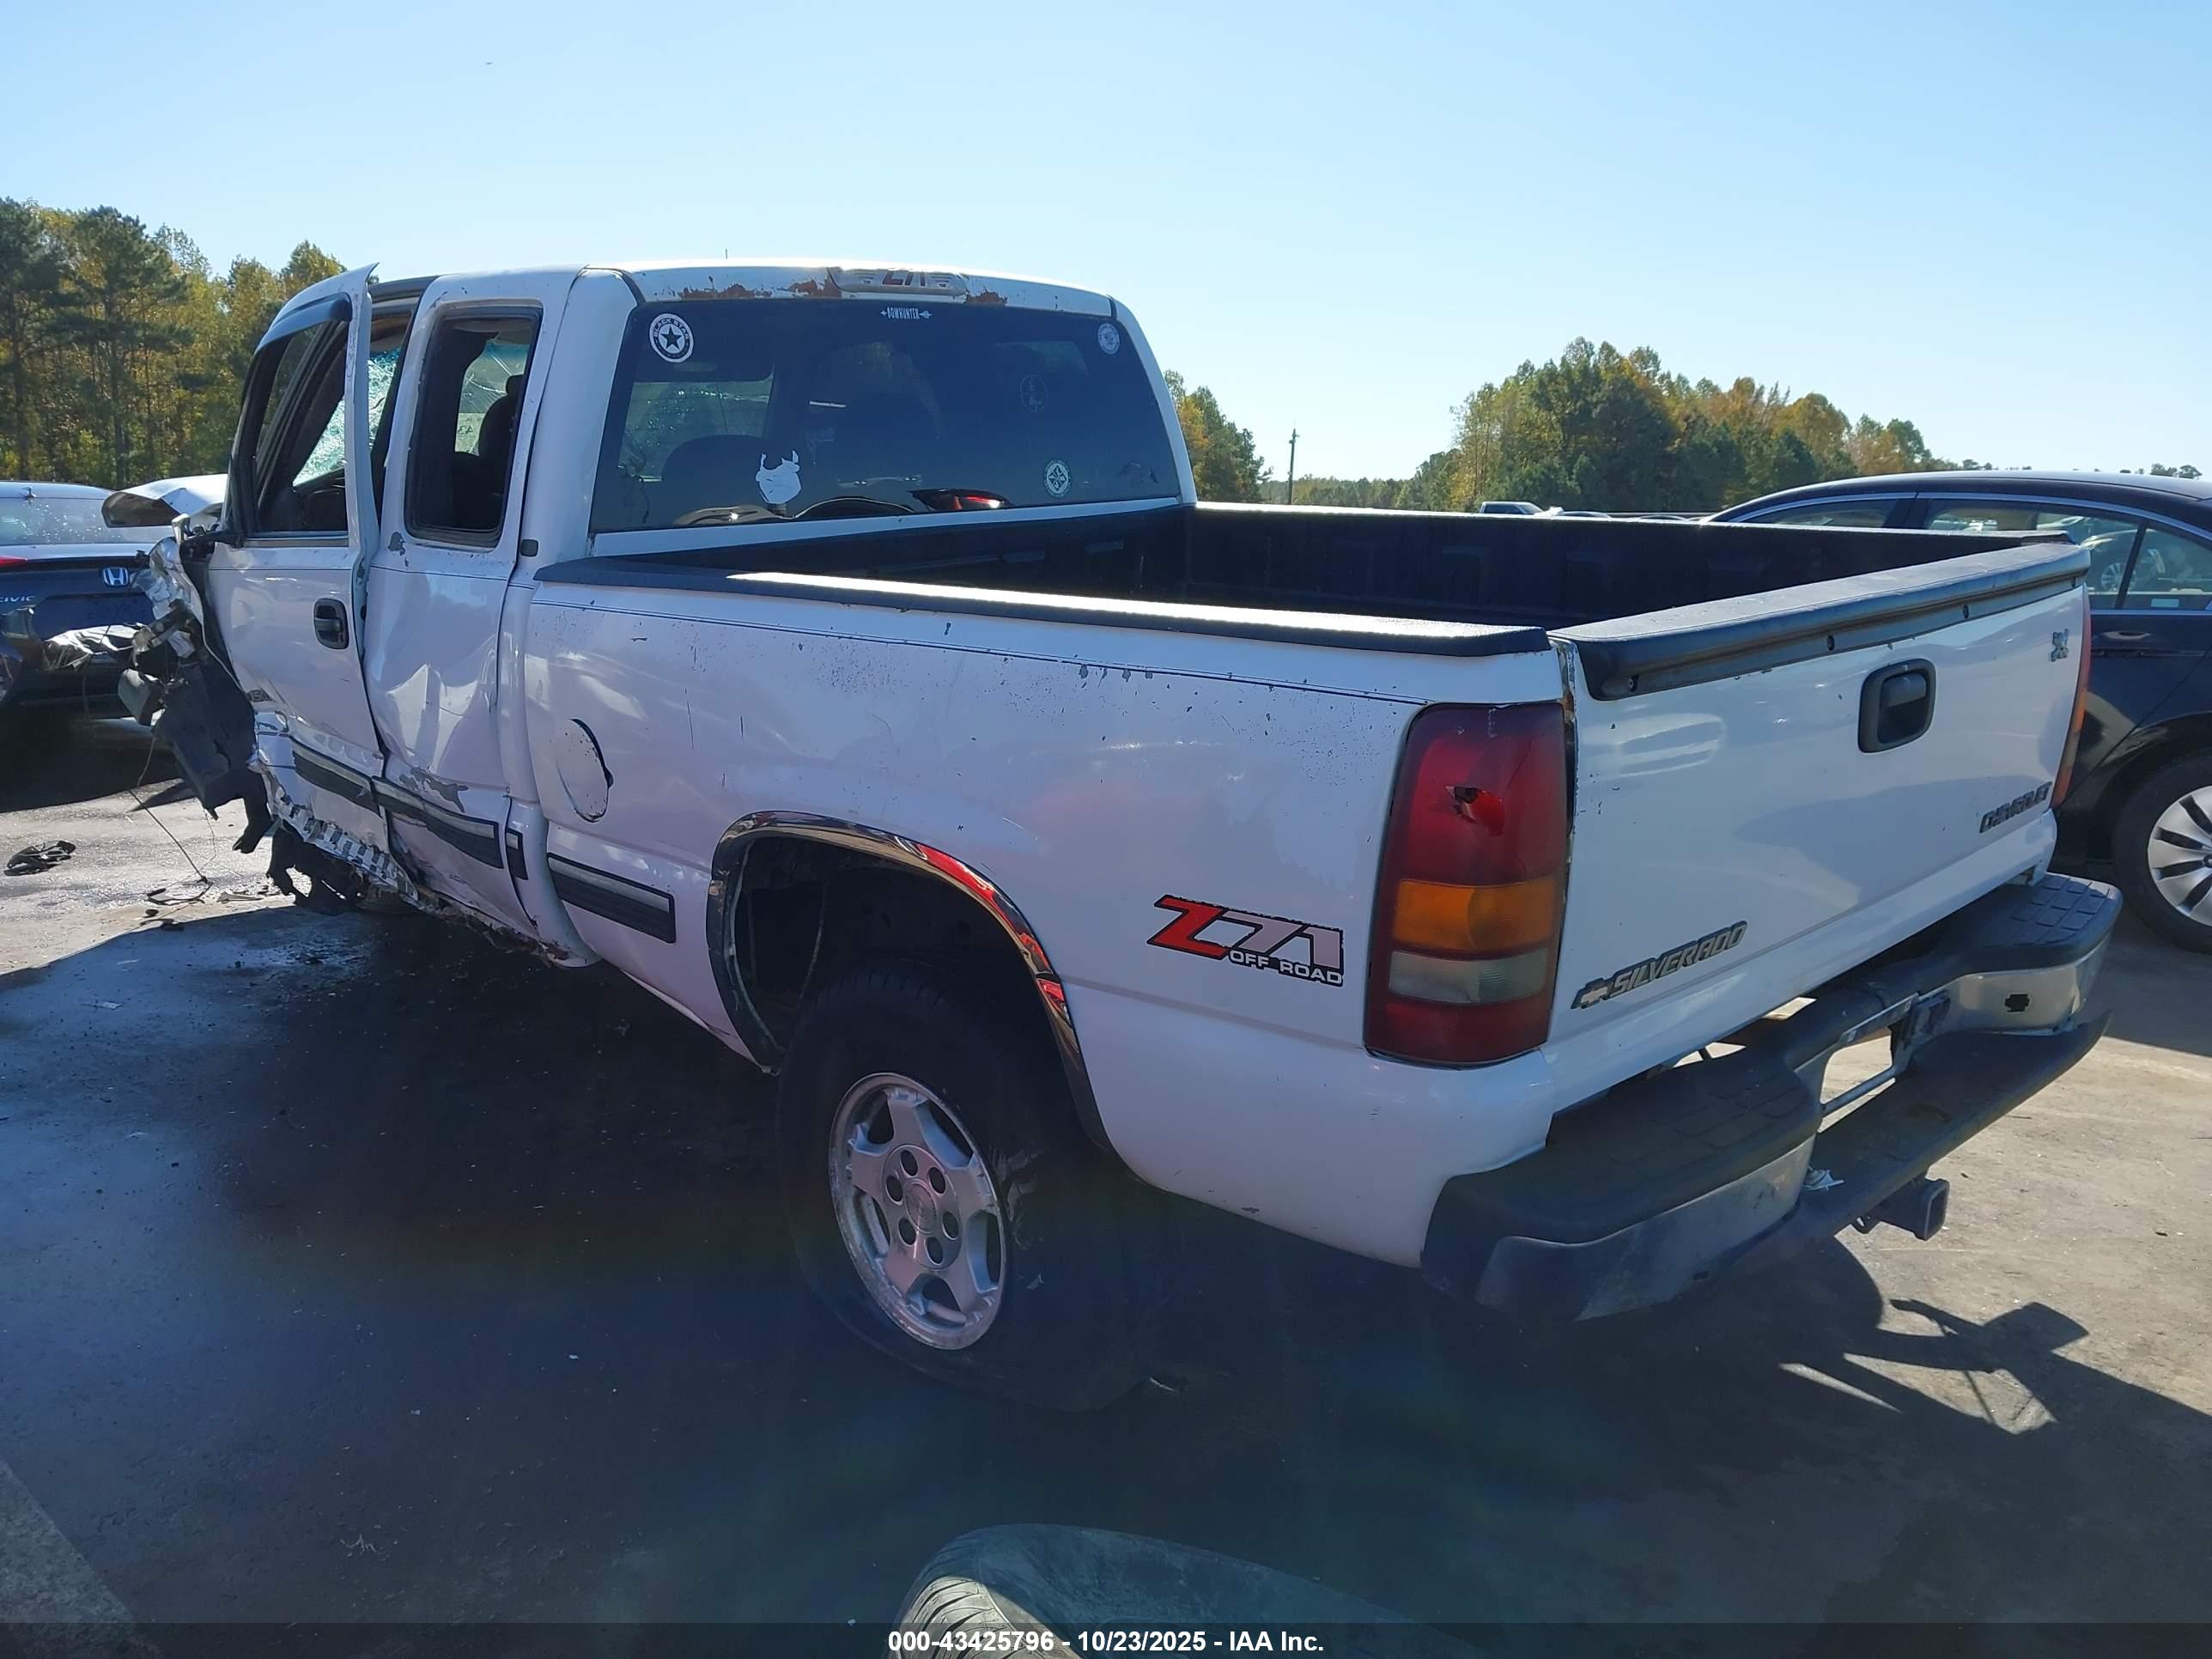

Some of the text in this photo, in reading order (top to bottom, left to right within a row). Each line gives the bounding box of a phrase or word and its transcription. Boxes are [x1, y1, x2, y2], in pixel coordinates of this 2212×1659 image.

[653, 318, 690, 340] BLACK STAR
[886, 307, 921, 320] BOWHUNTER
[1147, 894, 1343, 970] Z71
[1229, 949, 1343, 985] OFF ROAD
[1608, 921, 1748, 1000] SILVERADO
